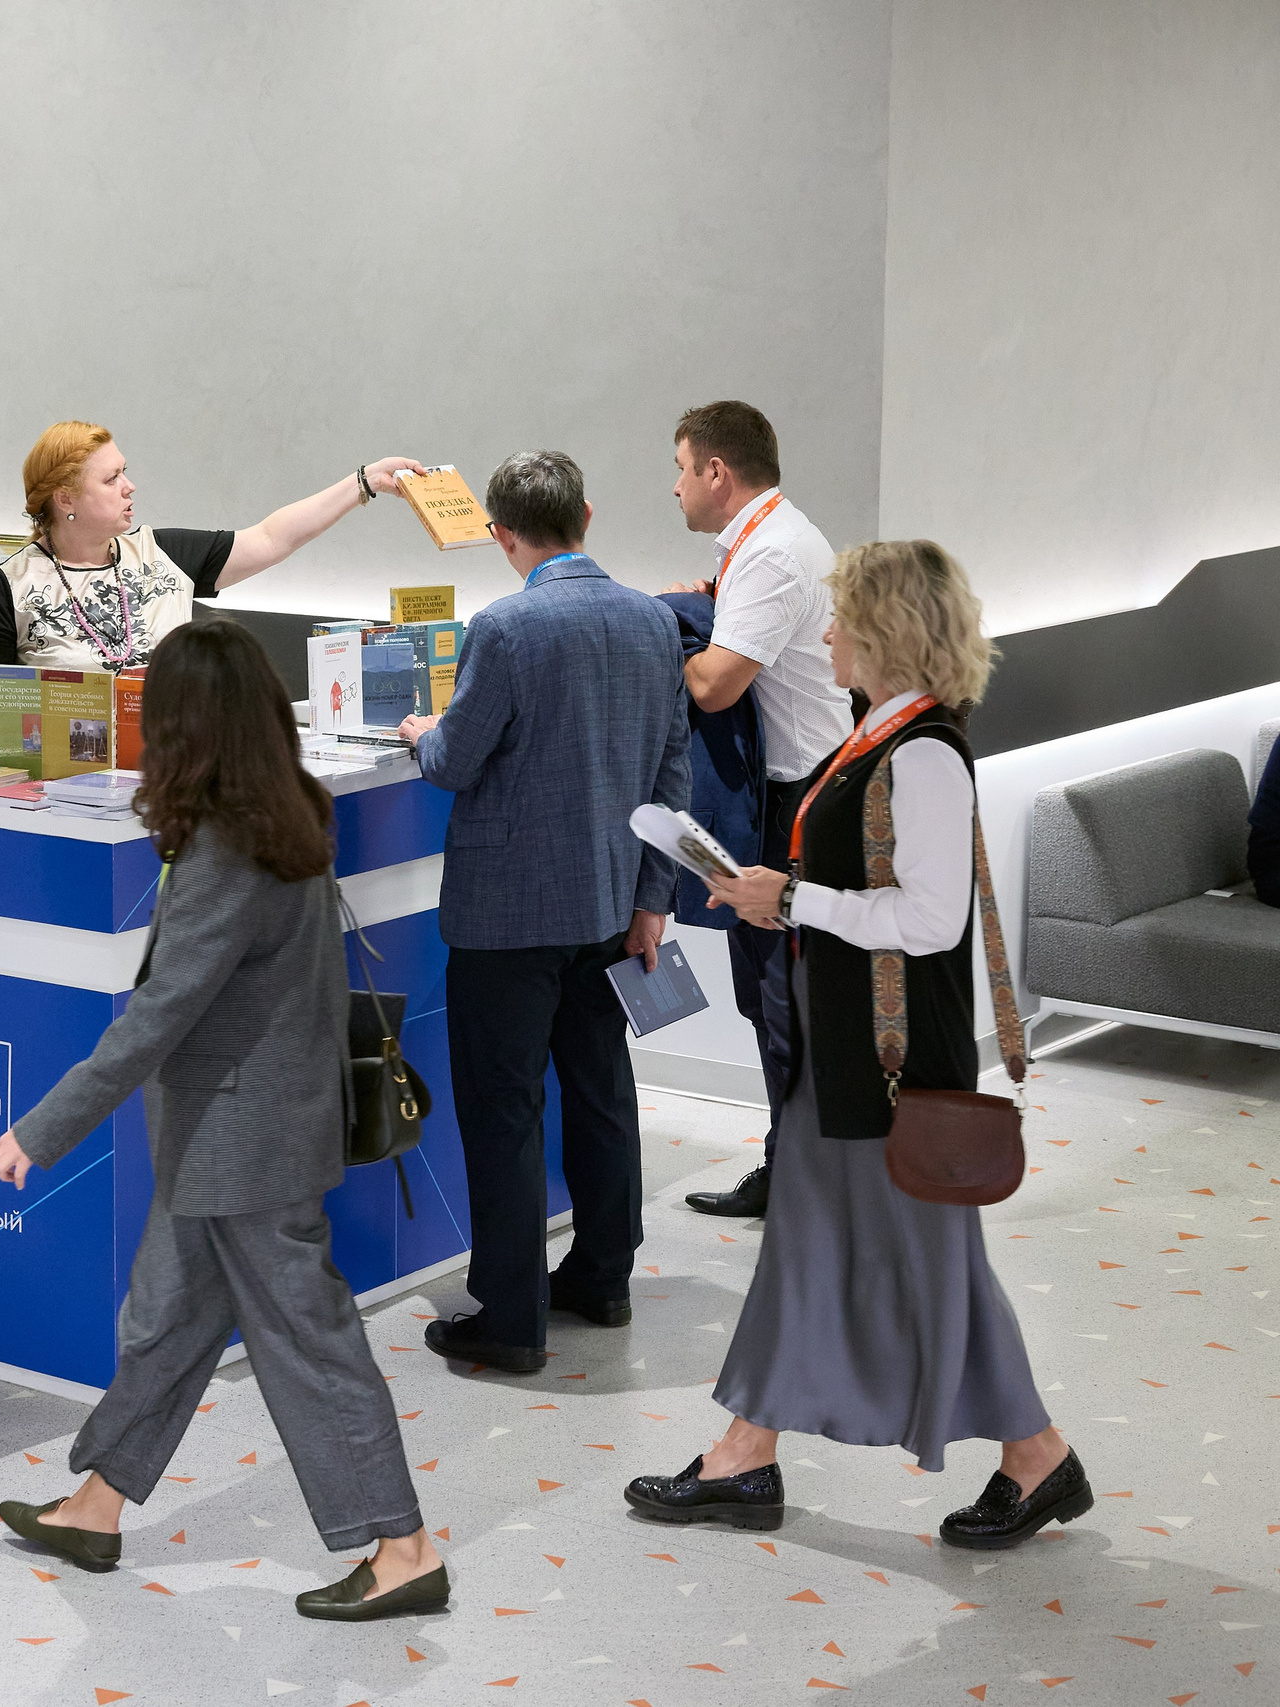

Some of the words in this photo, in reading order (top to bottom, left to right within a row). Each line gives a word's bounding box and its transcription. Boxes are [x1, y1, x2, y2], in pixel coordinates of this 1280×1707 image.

[425, 496, 474, 510] ПОЕЗДКА
[437, 510, 445, 518] В
[446, 507, 474, 517] ХИВУ
